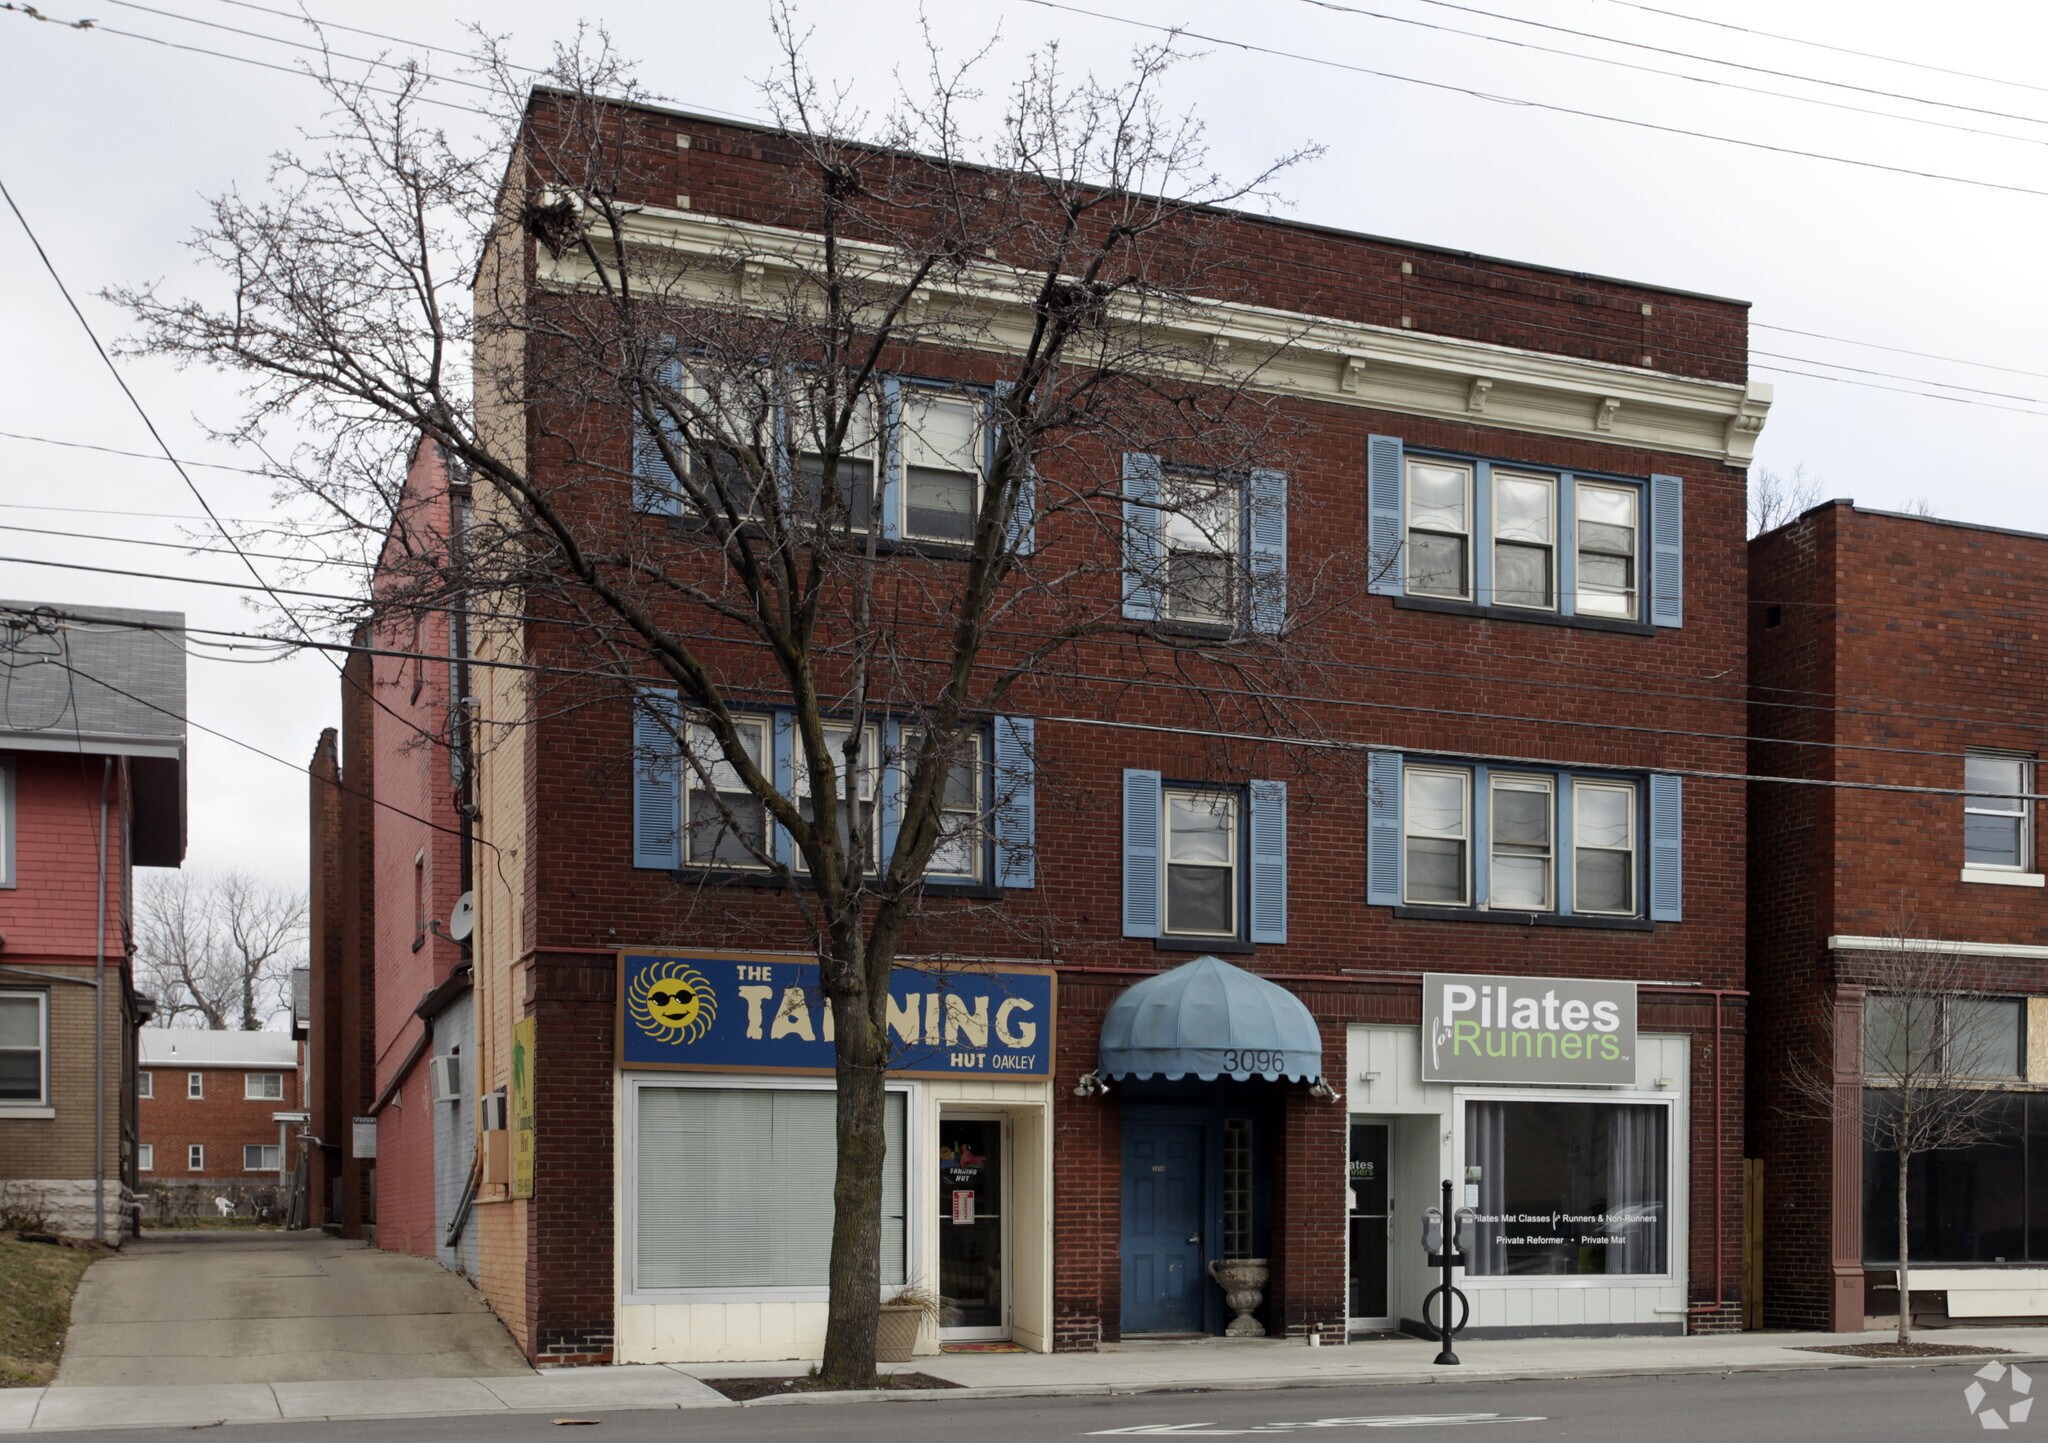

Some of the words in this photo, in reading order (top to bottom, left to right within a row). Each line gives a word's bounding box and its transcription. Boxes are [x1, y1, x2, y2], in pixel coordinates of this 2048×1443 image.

[737, 965, 772, 981] THE
[739, 985, 1037, 1048] TANING
[1443, 984, 1620, 1032] Pilates
[1432, 1016, 1453, 1070] for
[1453, 1020, 1620, 1060] Runners
[950, 1053, 986, 1068] HUT
[992, 1054, 1036, 1070] OAKLEY
[1223, 1050, 1284, 1072] 3096
[1501, 1214, 1517, 1223] Mat
[1518, 1214, 1551, 1223] Classes
[1562, 1214, 1596, 1223] Runners
[1597, 1214, 1604, 1223] &
[1605, 1214, 1657, 1223] Non-Runners
[1496, 1235, 1525, 1244] Private
[1526, 1235, 1564, 1244] Reformer
[1581, 1235, 1609, 1244] Private
[1611, 1235, 1626, 1244] Mat
